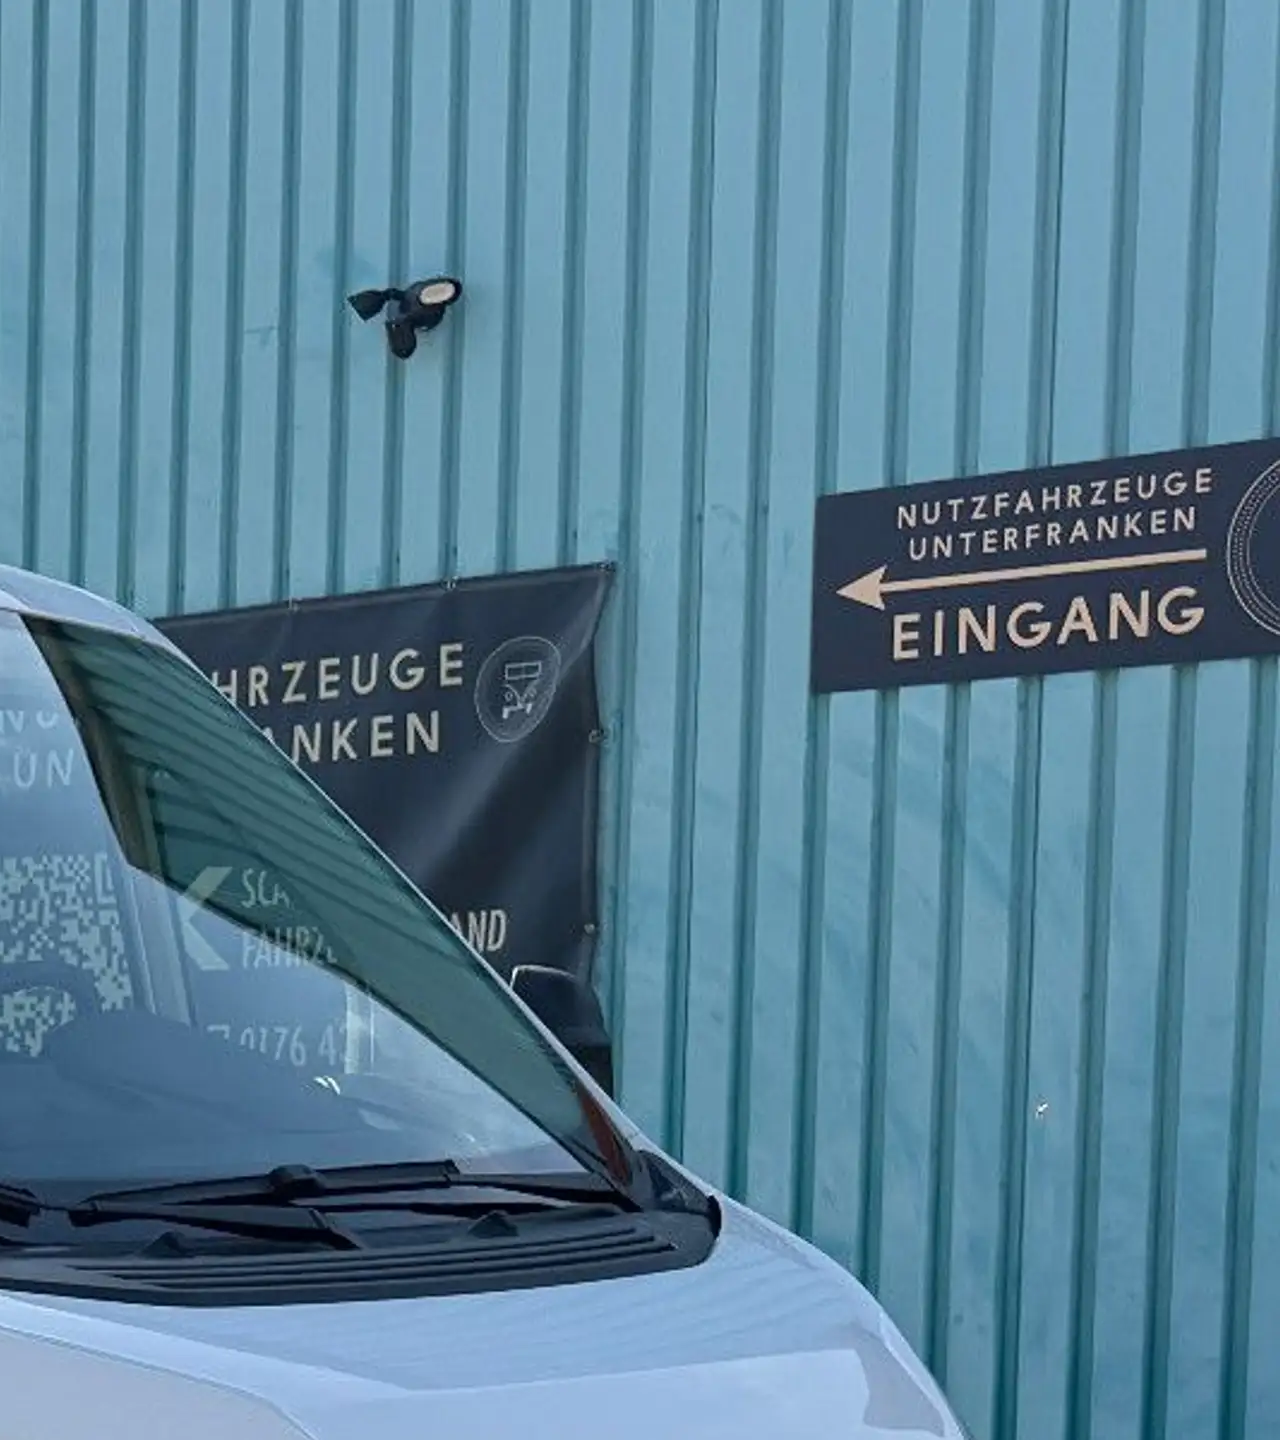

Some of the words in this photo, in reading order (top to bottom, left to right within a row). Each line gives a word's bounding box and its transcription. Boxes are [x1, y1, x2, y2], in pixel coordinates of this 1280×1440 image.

[897, 467, 1213, 530] NUTZFAHRZEUGE
[908, 506, 1196, 561] UNTERFRANKEN
[892, 585, 1205, 661] EINGANG
